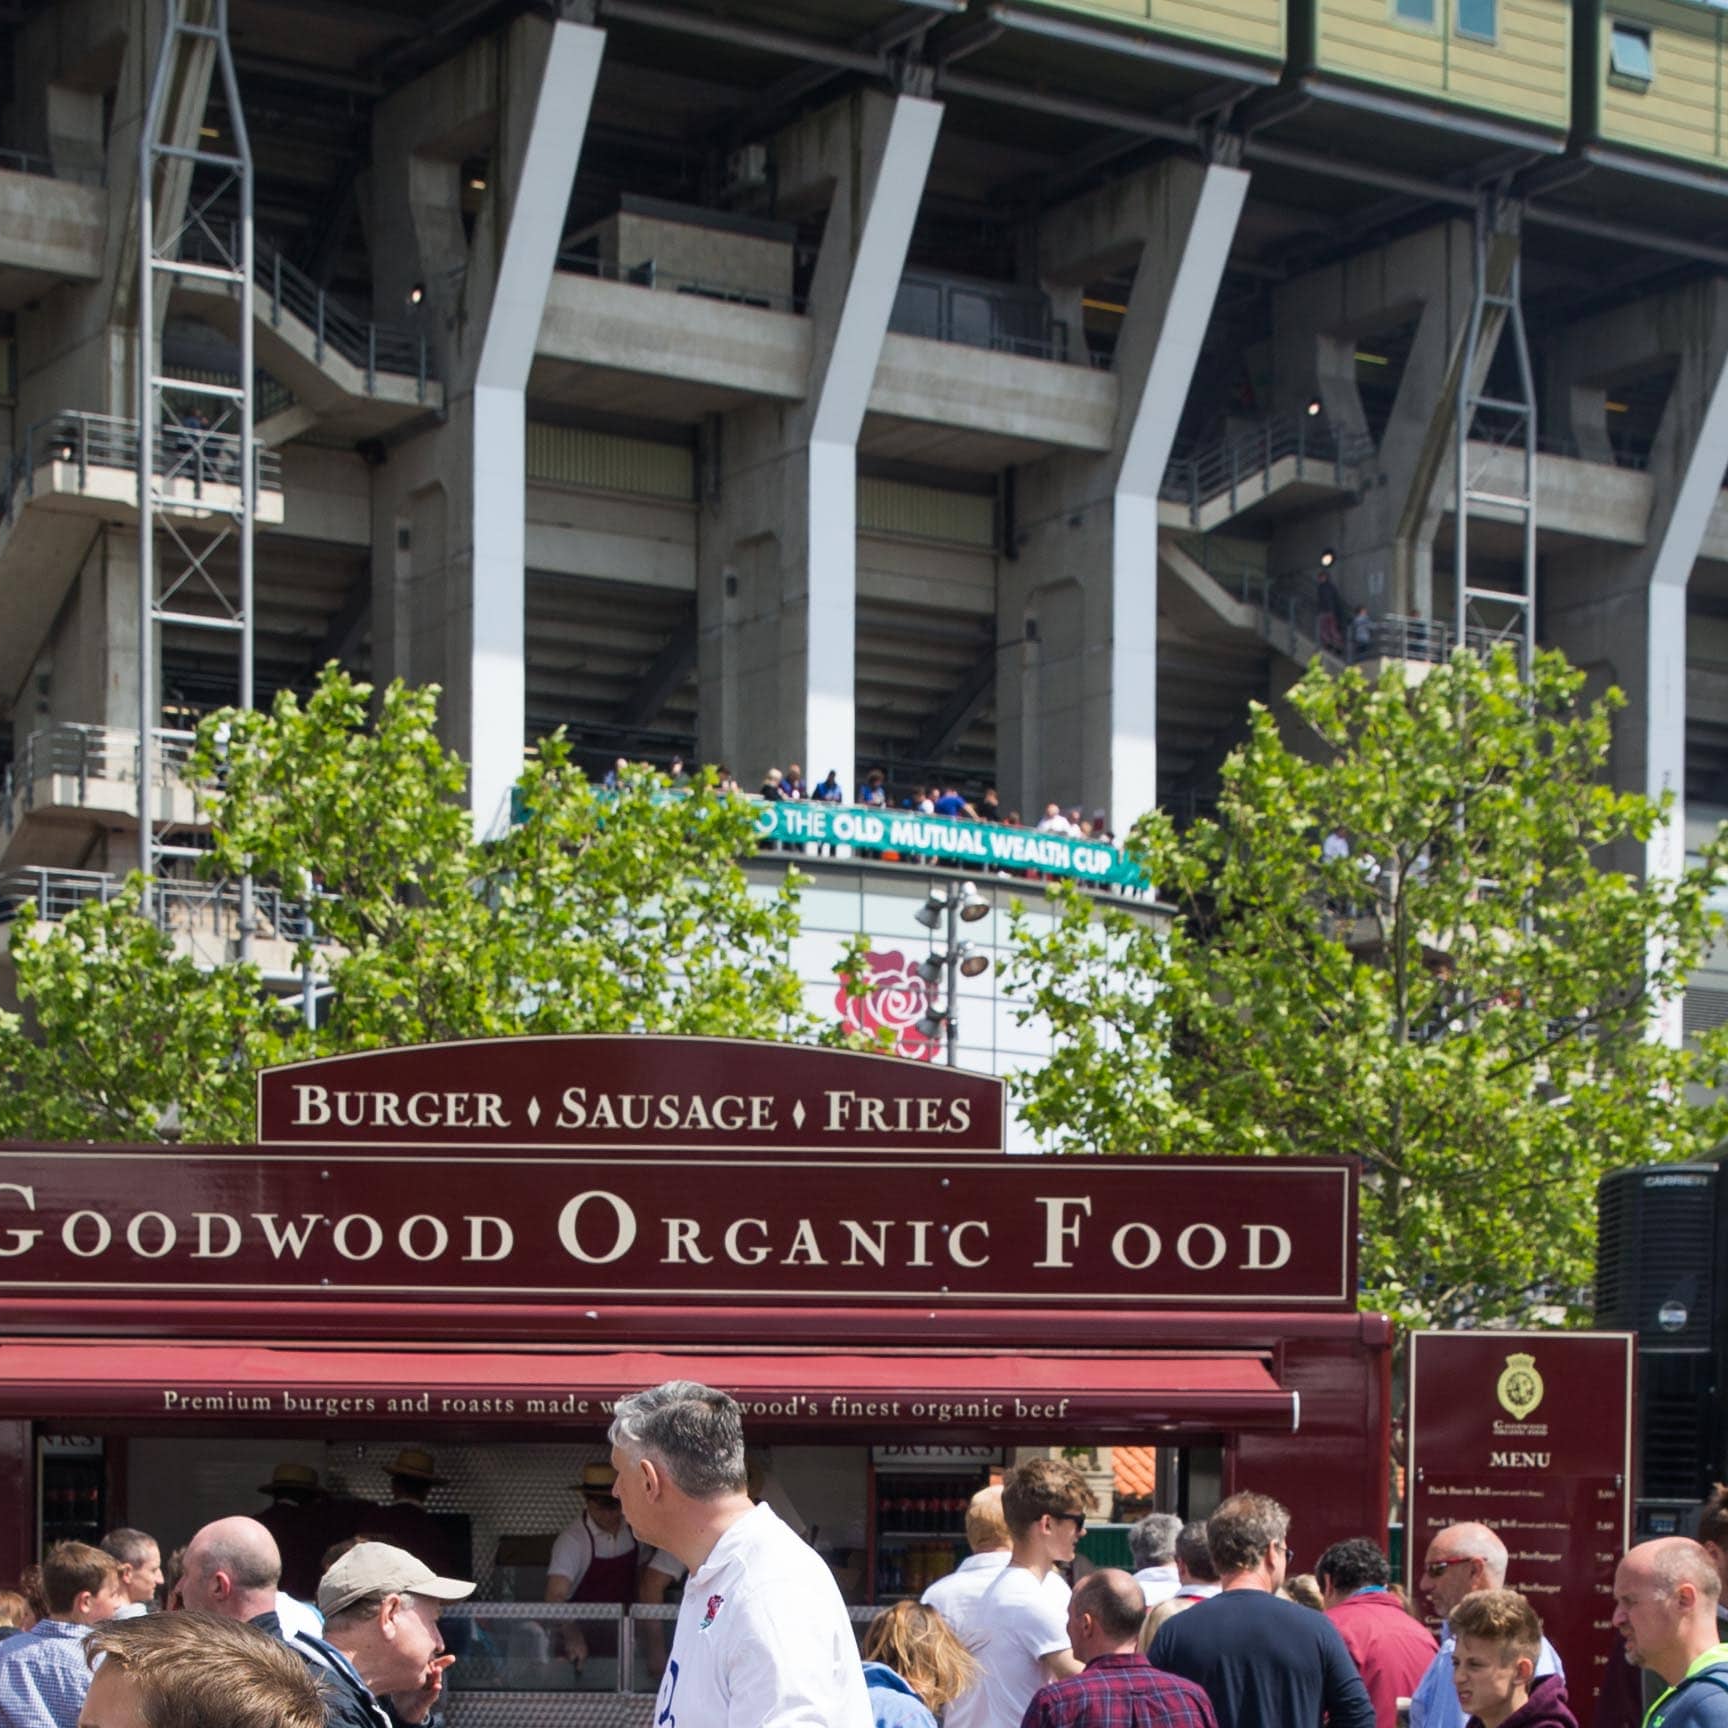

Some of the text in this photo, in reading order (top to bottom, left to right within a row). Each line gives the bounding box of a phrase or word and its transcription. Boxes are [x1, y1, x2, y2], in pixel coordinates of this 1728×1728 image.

[783, 809, 828, 839] THE
[832, 813, 884, 843] OLD
[889, 820, 988, 857] MUTUAL
[988, 832, 1071, 869] WEALTH
[1072, 846, 1112, 876] CUP
[292, 1085, 970, 1132] BURGER SAUSAGE FRIES
[558, 1188, 990, 1268] ORGANIC
[1033, 1195, 1293, 1270] FOOD
[163, 1390, 271, 1410] Premium
[282, 1391, 375, 1417] burgers
[387, 1392, 429, 1411] and
[442, 1396, 515, 1412] roasts
[526, 1393, 589, 1413] made
[830, 1396, 900, 1416] finest
[912, 1396, 1006, 1420] organic
[1015, 1397, 1069, 1418] beef
[1489, 1451, 1551, 1468] MENU
